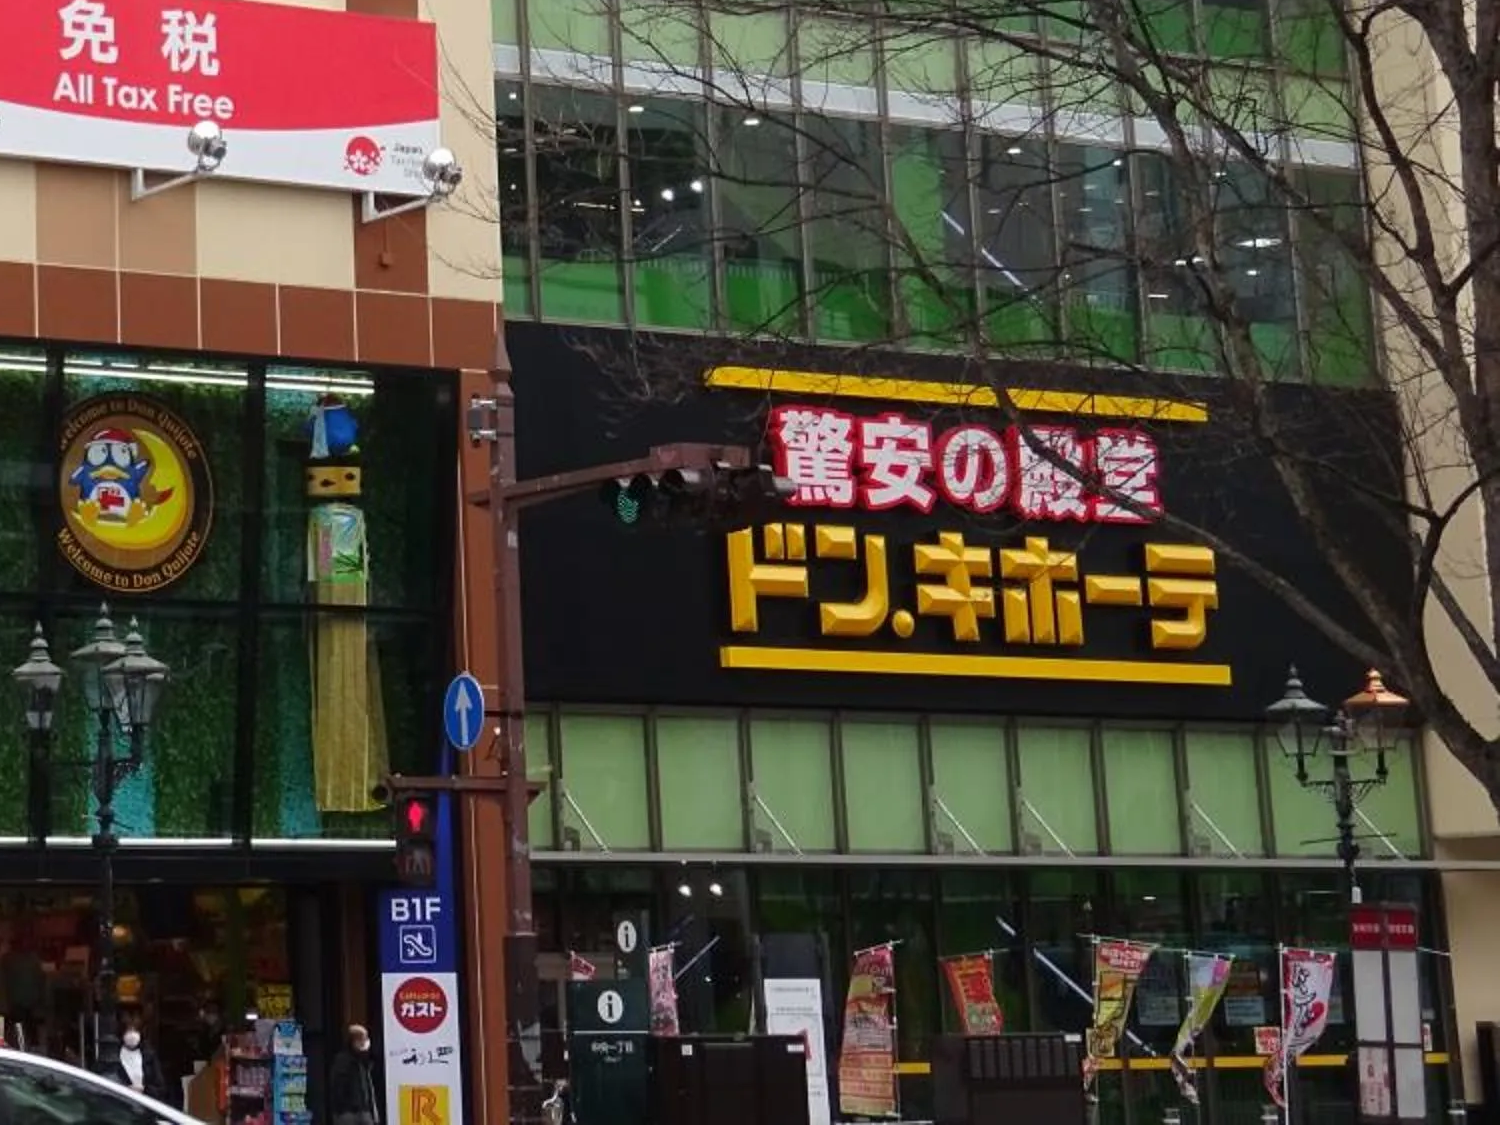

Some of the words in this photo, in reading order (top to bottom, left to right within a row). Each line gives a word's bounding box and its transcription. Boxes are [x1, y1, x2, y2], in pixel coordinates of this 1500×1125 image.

[53, 73, 94, 105] All
[104, 77, 158, 112] Tax
[167, 85, 234, 121] Free
[109, 399, 124, 412] to
[126, 399, 156, 416] Don
[58, 527, 111, 585] Welcome
[115, 574, 130, 589] to
[133, 572, 162, 589] Don
[161, 530, 201, 577] Quijote
[391, 897, 441, 922] B1F
[401, 1001, 443, 1018] ガスト
[411, 1087, 445, 1125] R
